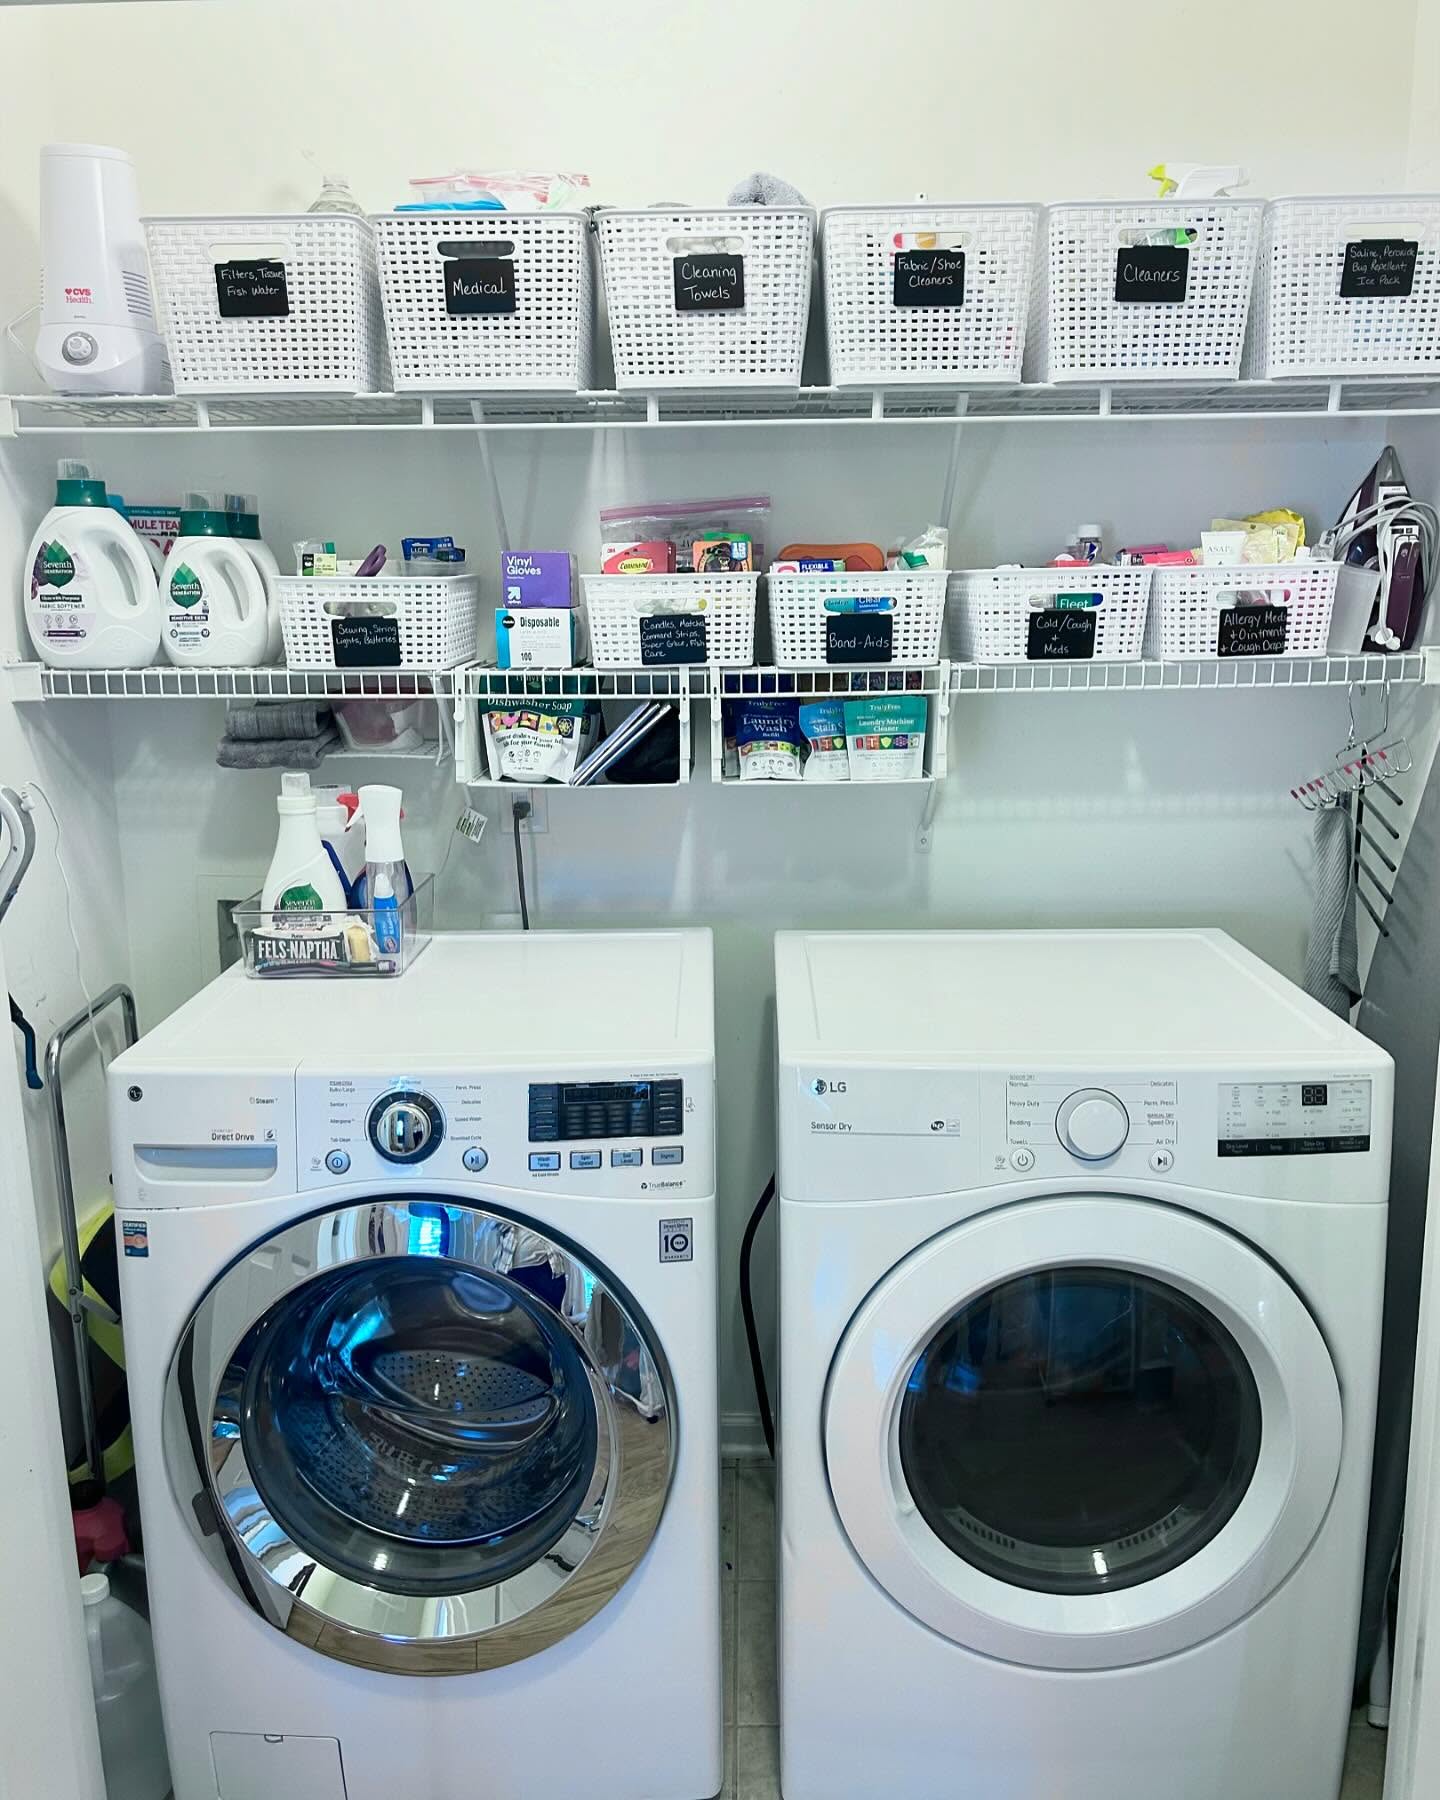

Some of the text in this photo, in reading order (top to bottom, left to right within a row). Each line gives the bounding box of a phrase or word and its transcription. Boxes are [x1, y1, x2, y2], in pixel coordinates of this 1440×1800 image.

[1350, 245, 1382, 259] Saline,
[1123, 263, 1181, 282] Cleaners
[1352, 262, 1368, 273] Bug
[221, 269, 258, 280] Filters,
[681, 262, 737, 285] Cleaning
[453, 276, 507, 296] Medical
[908, 275, 953, 288] Cleaners
[1356, 275, 1400, 286] Ice Pack
[73, 288, 91, 296] CVS
[227, 285, 279, 296] Fish Water
[683, 284, 730, 301] Towels
[130, 520, 181, 530] MULE TEA
[43, 561, 72, 569] Seventh
[507, 556, 533, 567] Vinyl
[507, 566, 542, 576] Gloves
[172, 582, 200, 590] Seventh
[1060, 599, 1089, 608] Fleet
[520, 616, 560, 629] Disposable
[1036, 614, 1092, 632] Cold/Cough
[1224, 612, 1261, 628] Allergy
[338, 624, 397, 637] Sewing, String
[829, 632, 890, 649] Band-Aids
[1044, 643, 1069, 655] Meds
[1231, 640, 1261, 654] Cough
[521, 652, 532, 661] 100
[644, 649, 667, 658] Care
[552, 700, 573, 712] Soap
[743, 716, 796, 729] Laundry
[754, 723, 787, 733] Wash
[813, 722, 838, 733] Stain
[859, 719, 914, 730] Laundry Machine
[873, 725, 899, 733] Cleaner
[257, 940, 339, 960] FELS-NAPTHA
[830, 1082, 847, 1093] LG
[811, 1121, 852, 1132] Sensor Dry
[1009, 1119, 1031, 1127] Bedding
[211, 1132, 255, 1141] Direct Drive
[663, 1233, 689, 1253] 10
